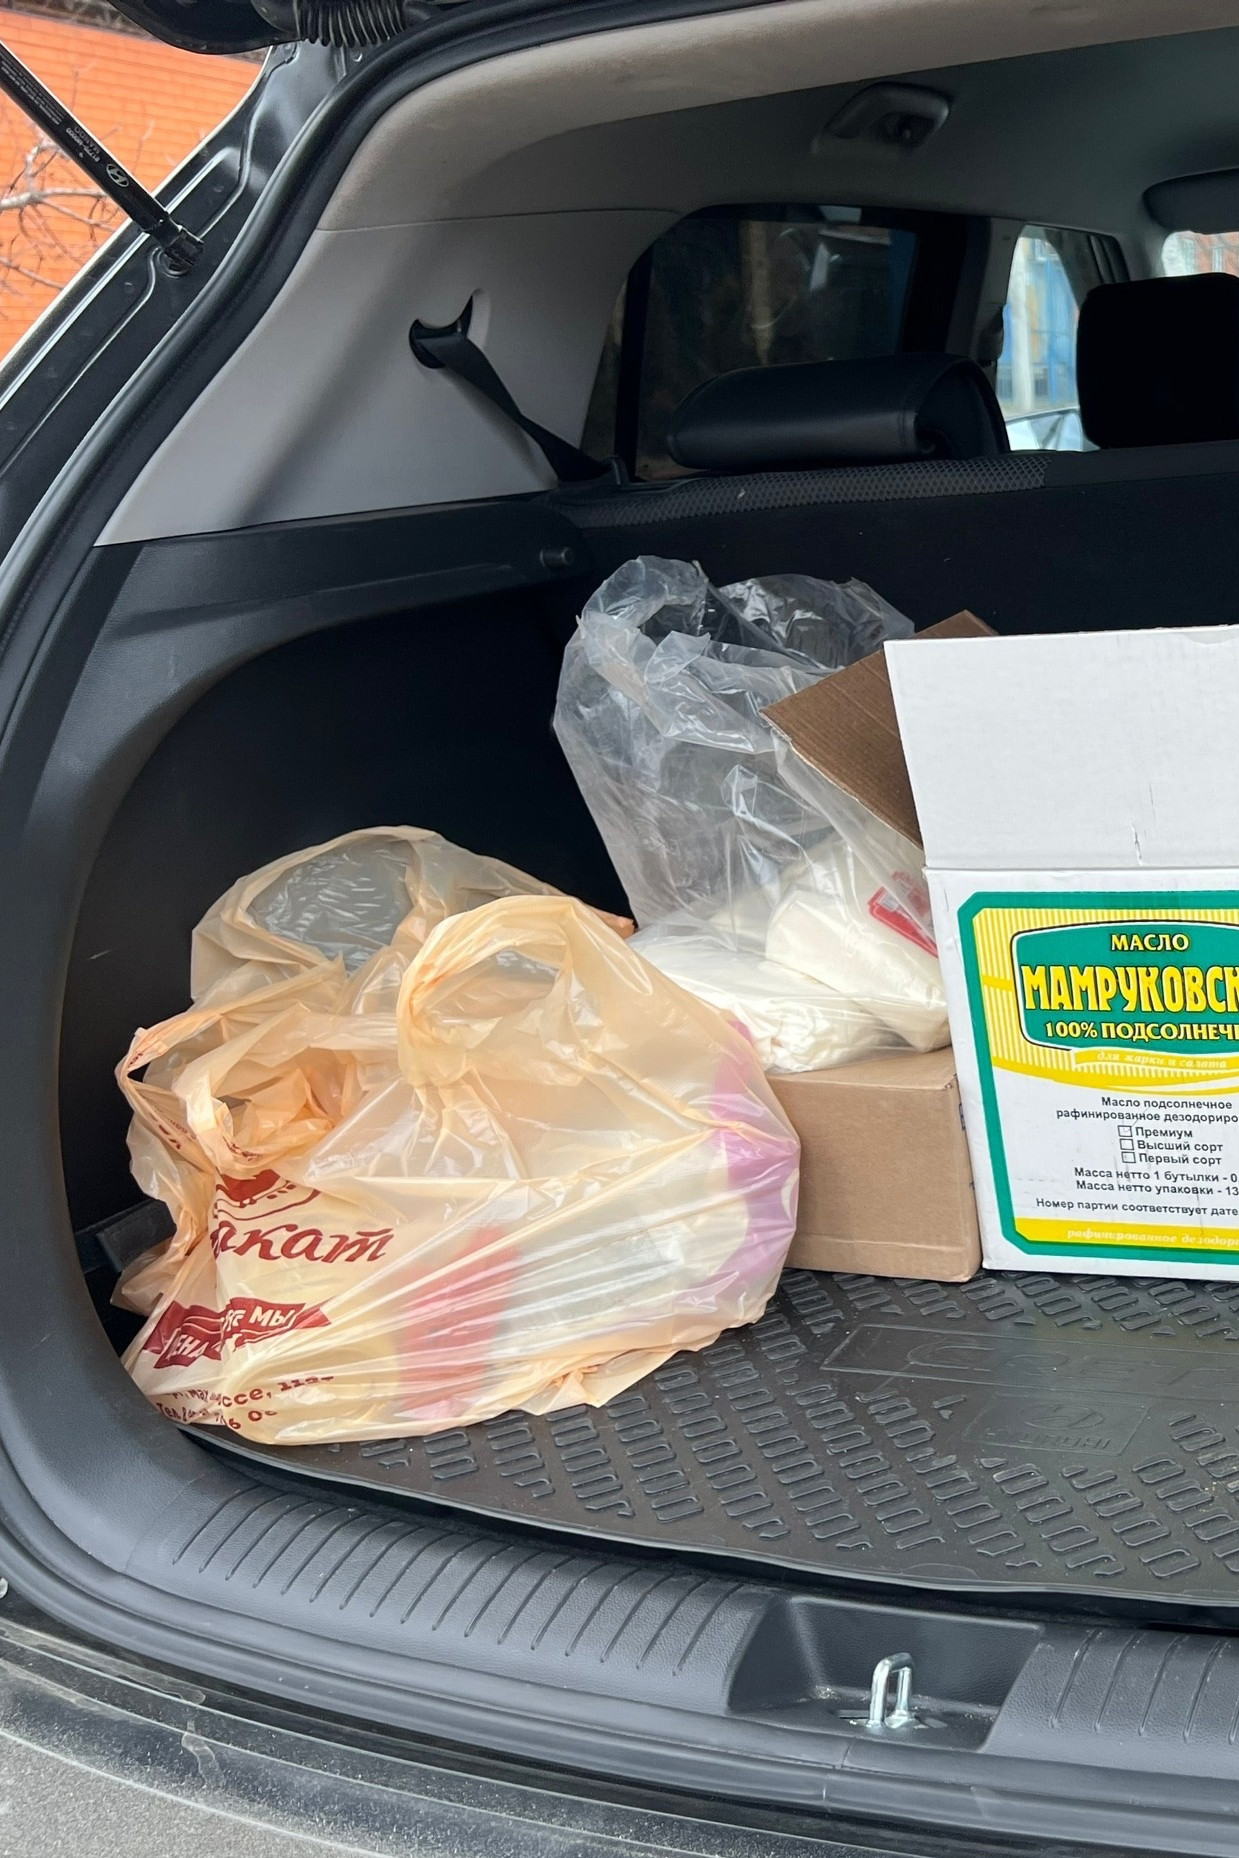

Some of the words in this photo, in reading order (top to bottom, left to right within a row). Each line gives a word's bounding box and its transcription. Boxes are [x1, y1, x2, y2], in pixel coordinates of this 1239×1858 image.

[1110, 933, 1190, 951] МАСЛО
[1045, 1021, 1097, 1039] 100%
[1101, 1097, 1141, 1108] Масло
[1144, 1099, 1233, 1111] подсолнечное
[1056, 1108, 1161, 1122] рафинированное
[1135, 1126, 1193, 1139] Премиум
[1137, 1139, 1191, 1151] Высший
[1194, 1143, 1223, 1154] сорт
[1139, 1152, 1190, 1166] Первый
[1193, 1156, 1222, 1167] сорт
[1074, 1167, 1113, 1179] Масса
[1116, 1171, 1151, 1181] нетто
[1154, 1171, 1160, 1180] 1
[1164, 1171, 1220, 1183] бутылки
[1076, 1180, 1115, 1191] Масса
[1118, 1184, 1152, 1194] нетто
[1155, 1185, 1214, 1197] упаковки
[1036, 1198, 1074, 1210] Номер
[1077, 1201, 1119, 1212] партии
[1121, 1203, 1208, 1217] соответствует
[1210, 1207, 1239, 1218] дате
